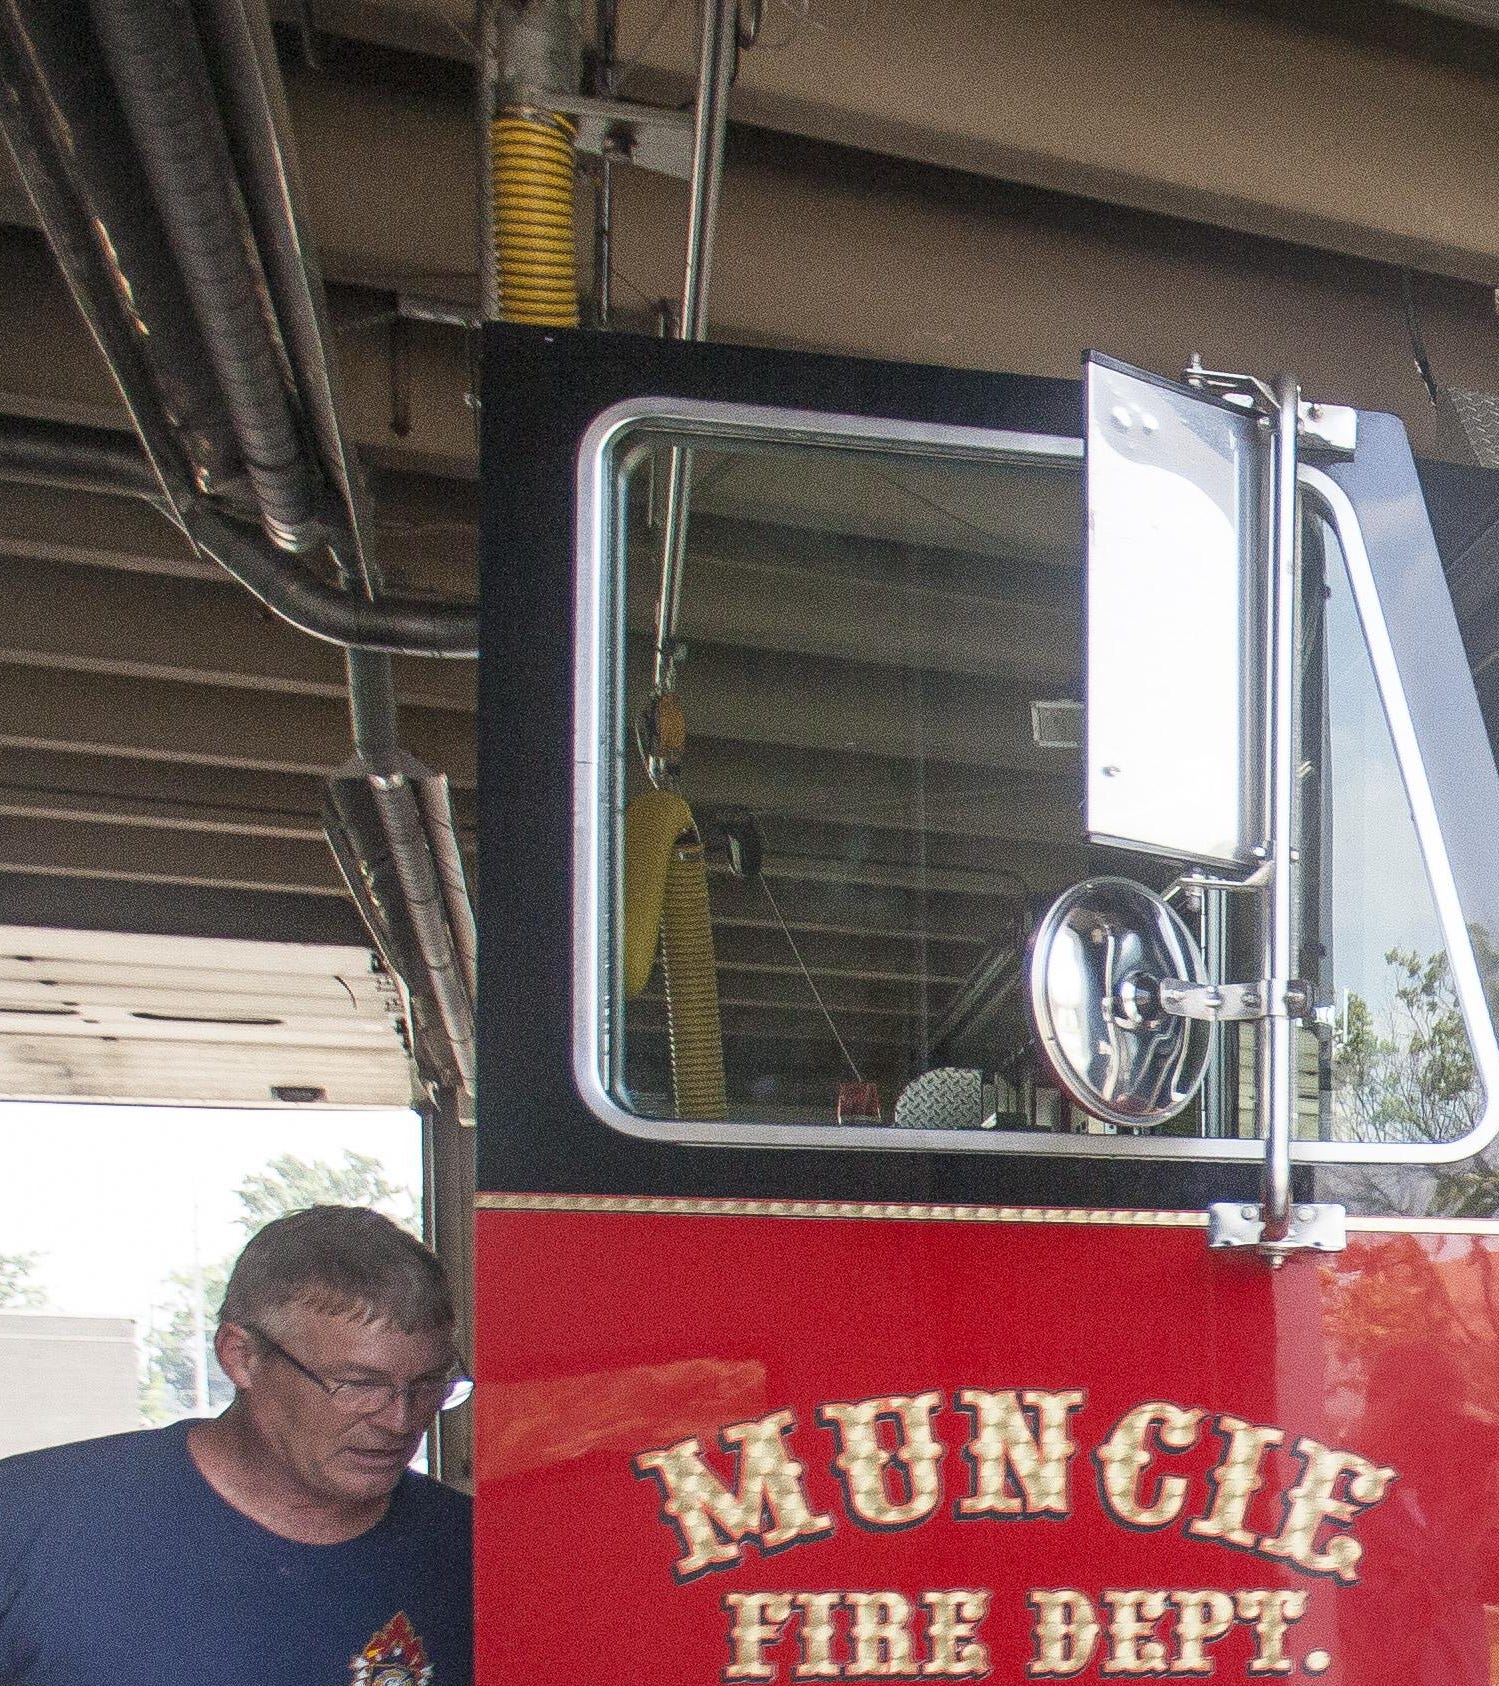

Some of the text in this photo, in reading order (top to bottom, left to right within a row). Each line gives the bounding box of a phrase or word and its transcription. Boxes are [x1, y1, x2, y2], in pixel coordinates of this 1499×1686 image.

[633, 1387, 1399, 1587] MUNCIE
[721, 1587, 1333, 1684] FIRE DEPT.
